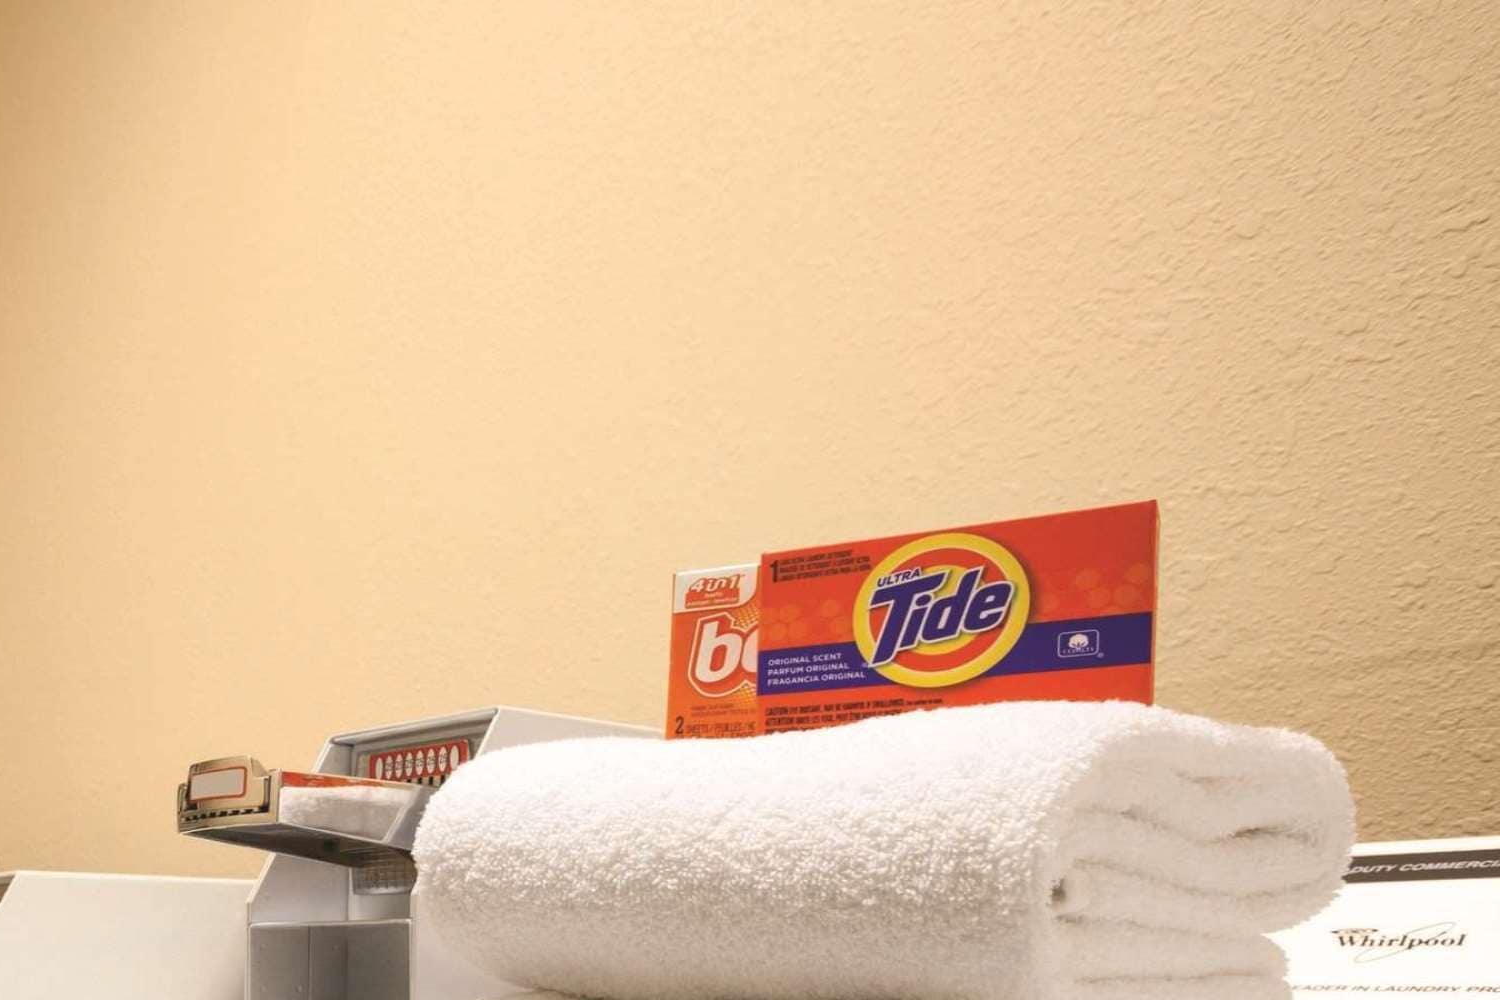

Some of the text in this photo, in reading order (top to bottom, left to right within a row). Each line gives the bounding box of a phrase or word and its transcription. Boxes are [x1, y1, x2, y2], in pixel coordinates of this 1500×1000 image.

[770, 560, 778, 583] 1
[877, 567, 921, 587] ULTRA
[869, 565, 1014, 667] Tide
[767, 653, 842, 666] ORIGINAL SCENT
[767, 662, 850, 676] PARFUM ORIGINAL
[767, 671, 866, 686] FRAGANCIA ORIGINAL
[675, 715, 684, 735] 2
[1350, 860, 1500, 873] DUTY COMMERCI
[1338, 933, 1467, 950] Whirlpool
[1291, 984, 1348, 992] EADER
